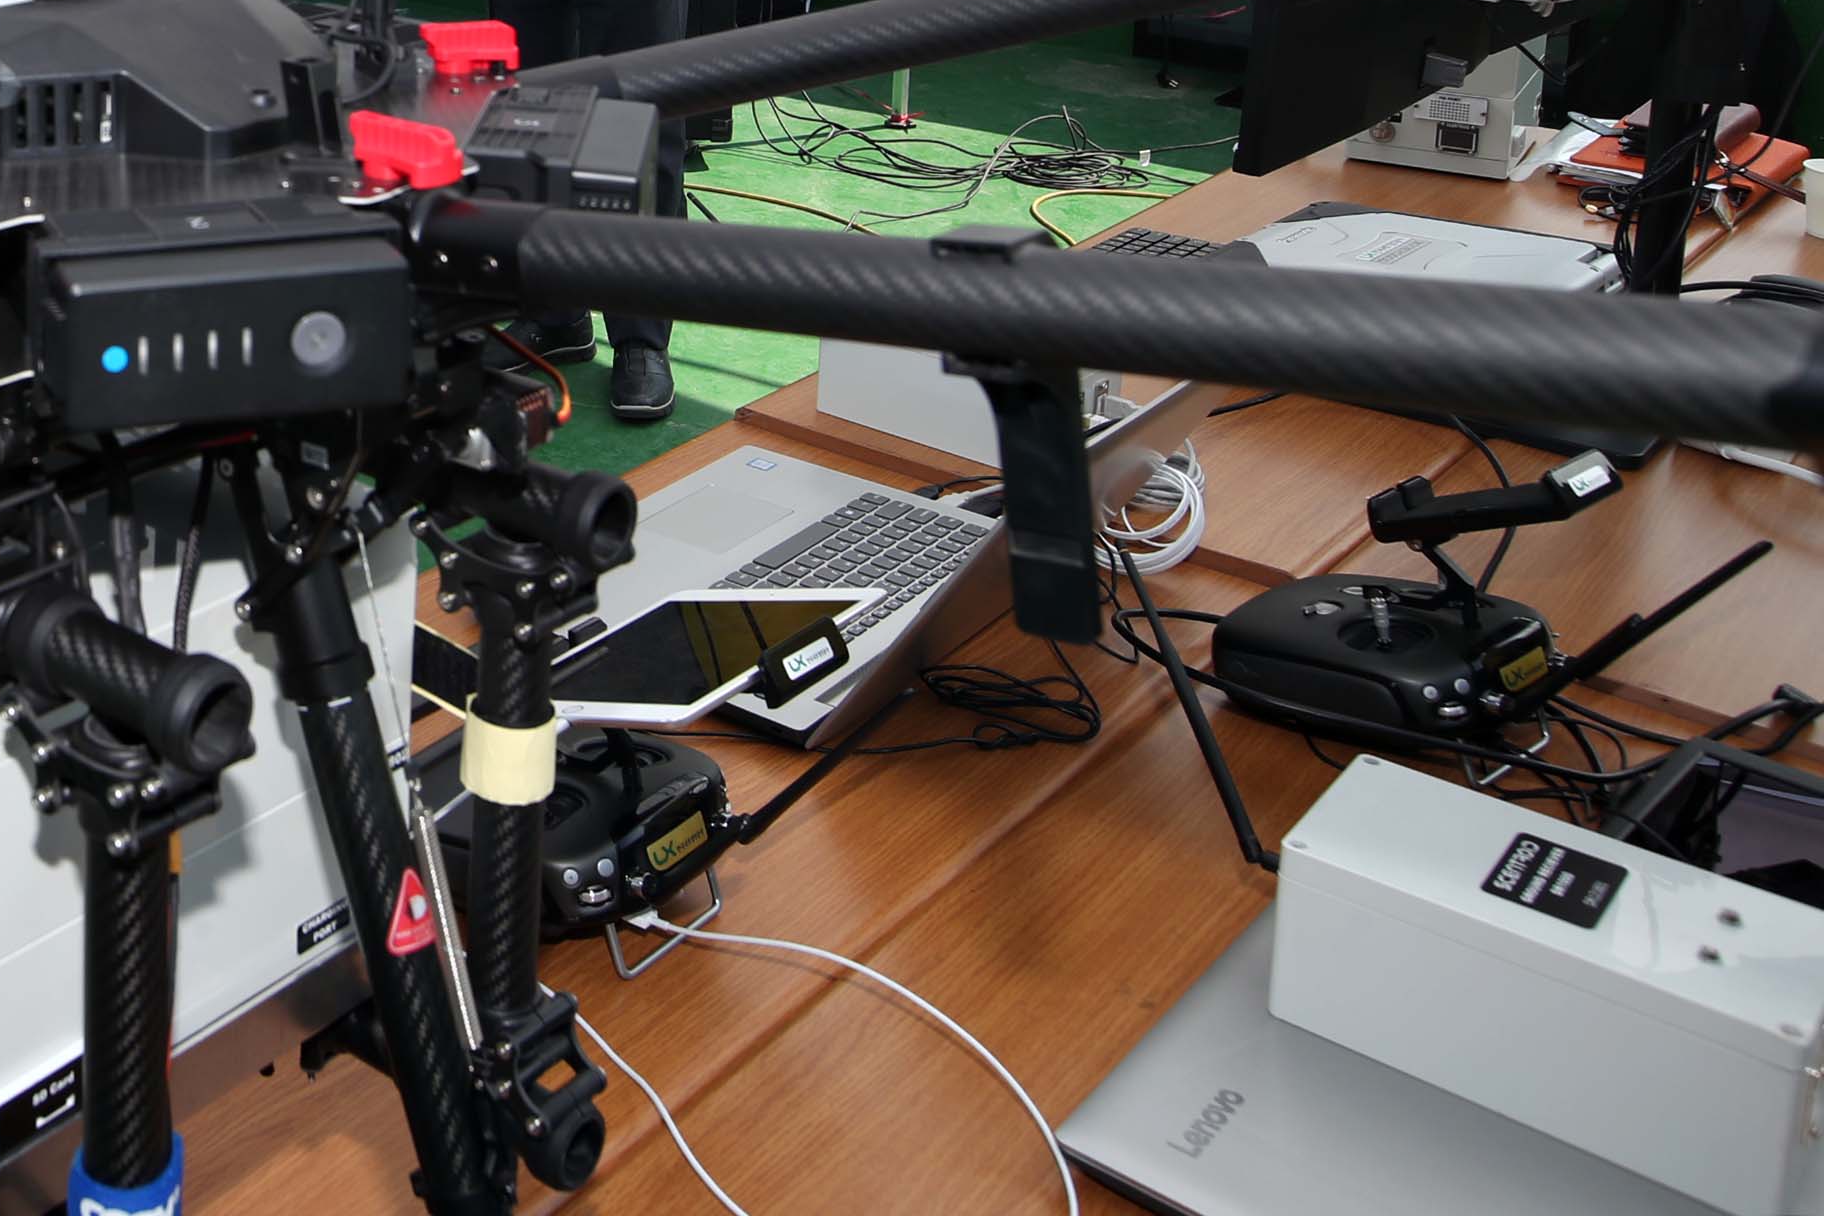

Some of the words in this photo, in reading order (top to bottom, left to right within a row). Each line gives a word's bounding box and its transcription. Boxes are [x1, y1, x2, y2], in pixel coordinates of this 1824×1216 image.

[32, 1087, 49, 1107] SD
[48, 1070, 76, 1096] Card
[1165, 1087, 1246, 1160] Lenovo
